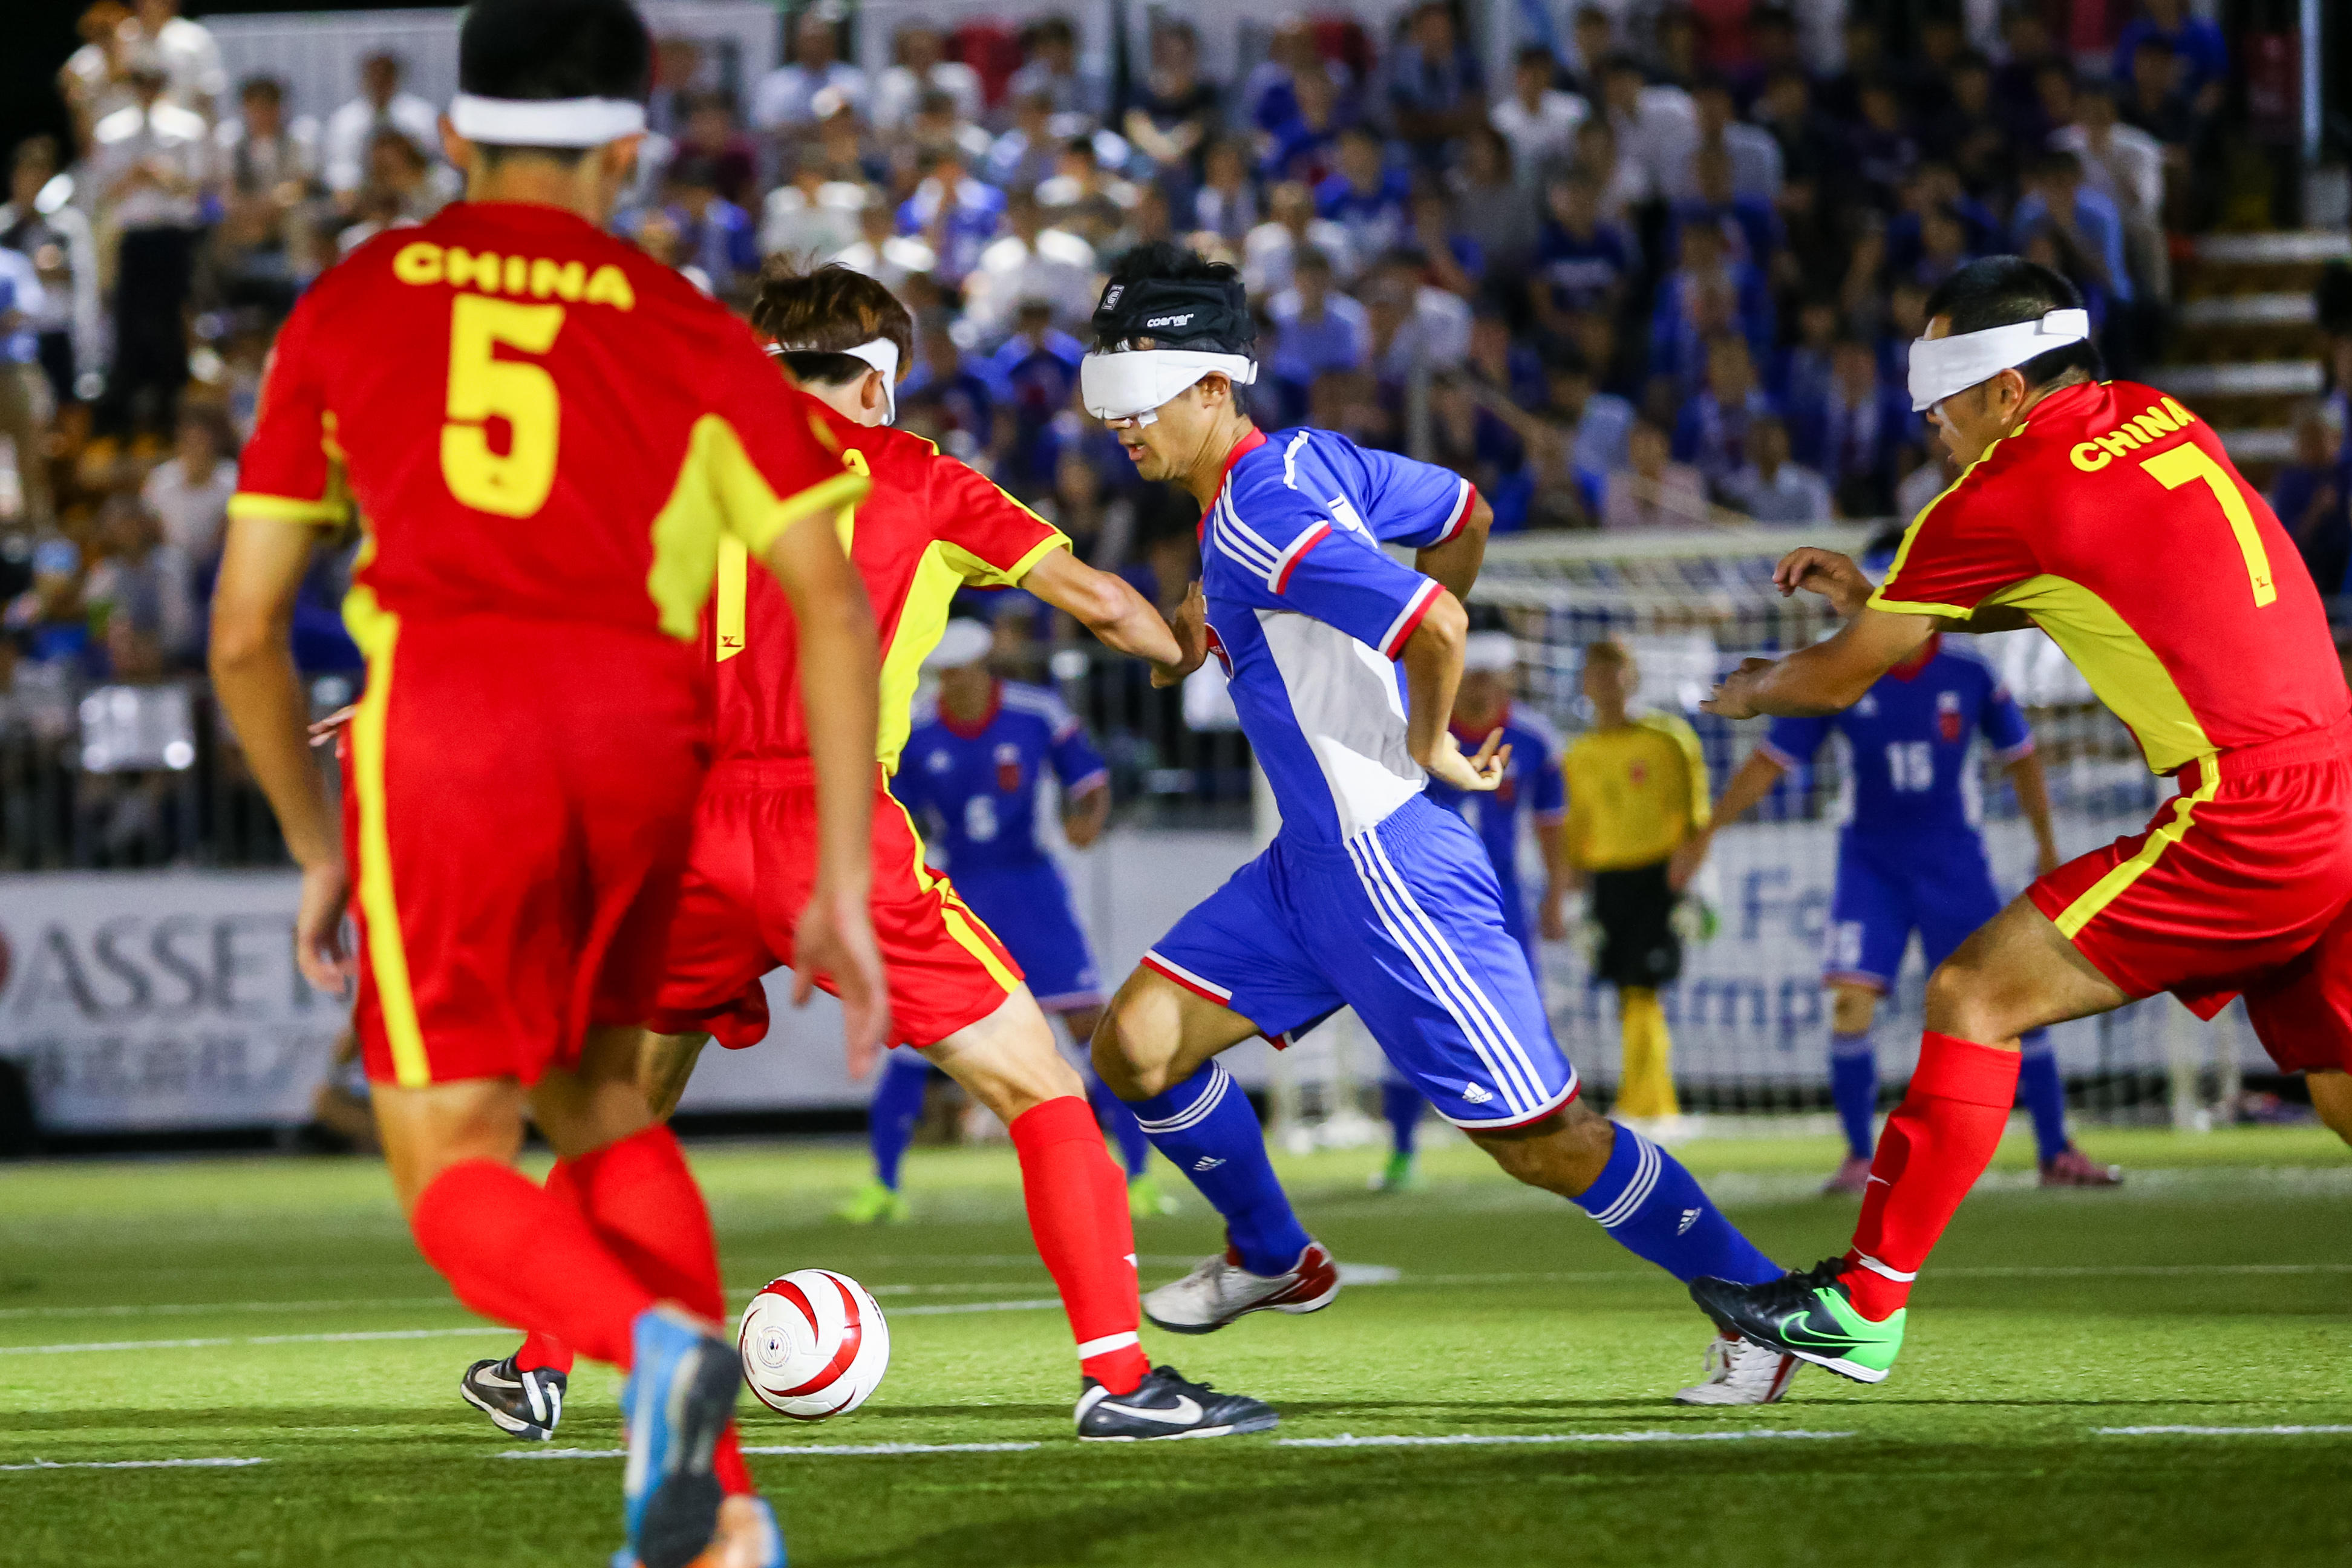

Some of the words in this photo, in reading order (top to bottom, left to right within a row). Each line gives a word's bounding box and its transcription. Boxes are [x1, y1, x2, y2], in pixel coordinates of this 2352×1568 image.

[393, 243, 636, 311] CHINA
[441, 293, 566, 518] 5
[2069, 397, 2195, 472] CHINA
[2139, 441, 2278, 608] 7
